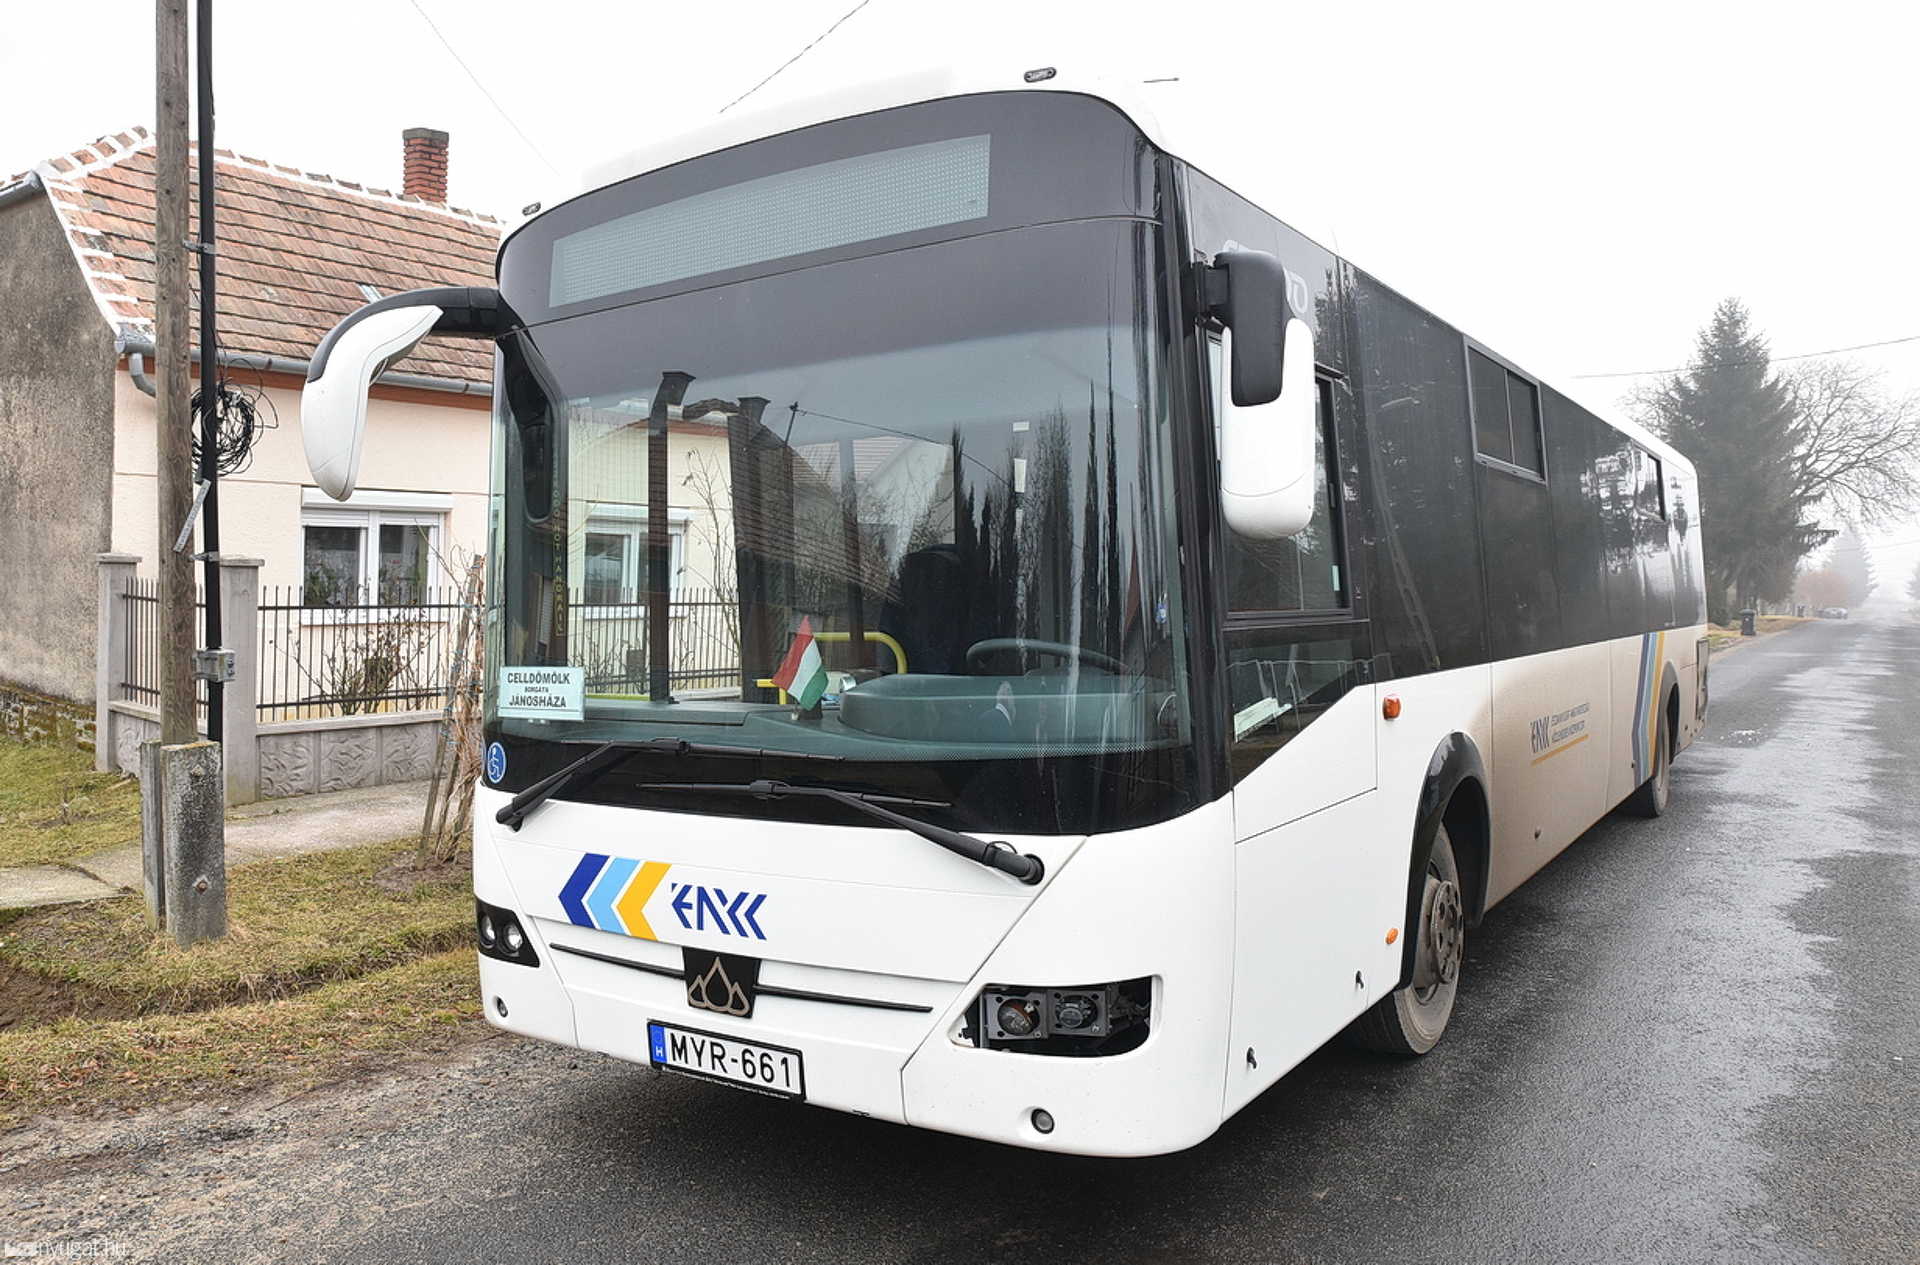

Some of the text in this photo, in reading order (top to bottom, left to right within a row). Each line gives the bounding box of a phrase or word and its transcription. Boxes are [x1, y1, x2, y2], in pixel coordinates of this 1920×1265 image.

[508, 671, 570, 684] CELLDÖMÖLK
[509, 693, 567, 708] JÁNOSHÁZA
[656, 1047, 664, 1057] H
[670, 1033, 791, 1087] MYR-661
